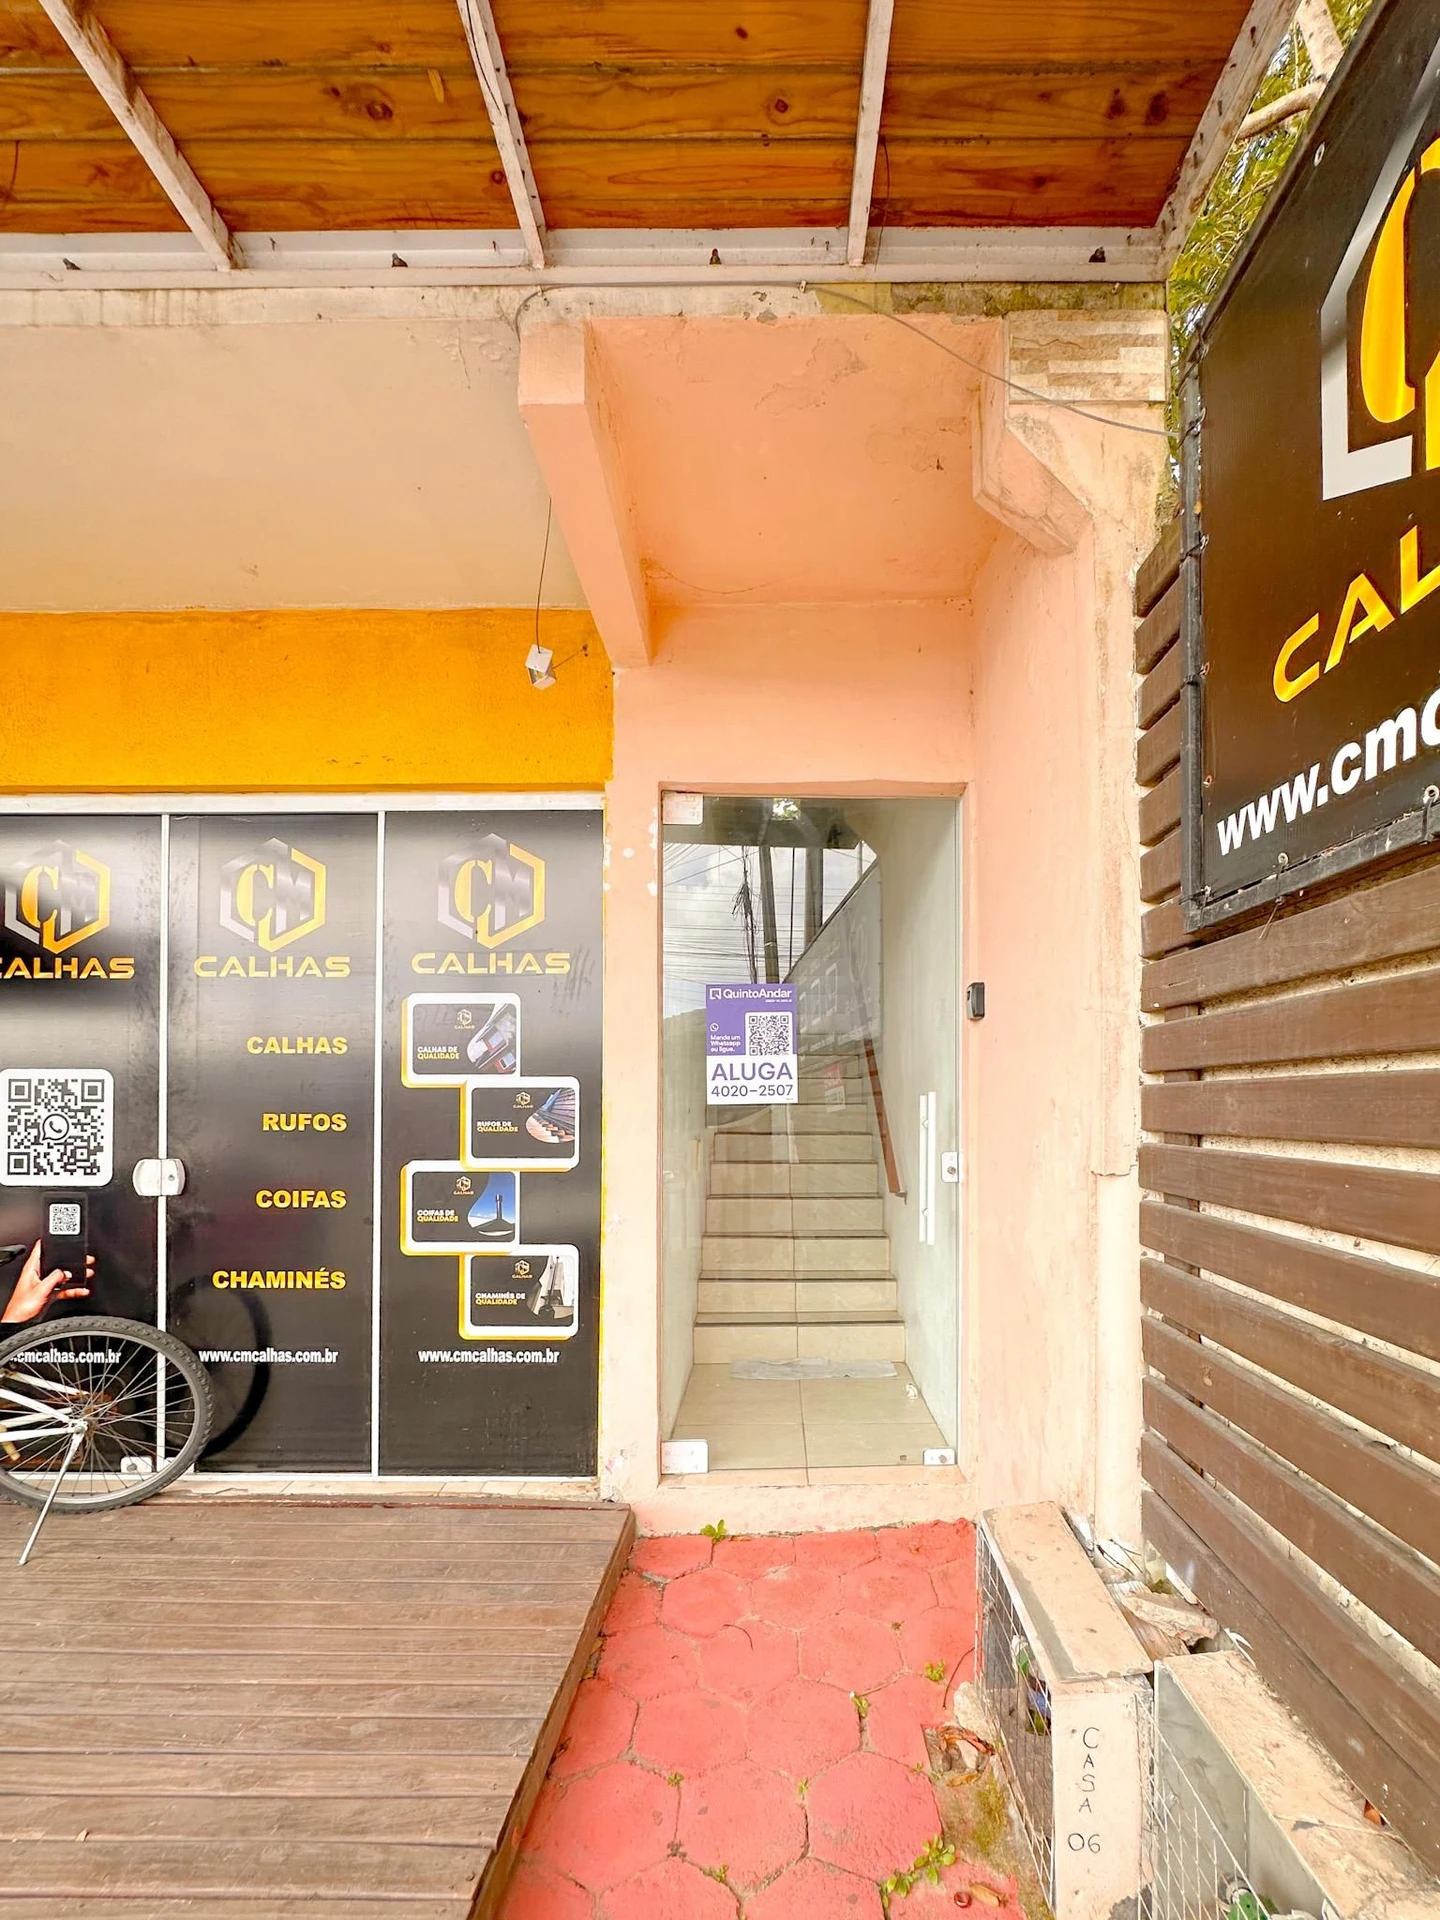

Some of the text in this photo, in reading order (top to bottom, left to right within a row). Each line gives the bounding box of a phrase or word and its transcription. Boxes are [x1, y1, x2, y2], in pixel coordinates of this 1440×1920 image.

[0, 957, 135, 979] ALHAS
[193, 956, 351, 978] CALHAS
[411, 952, 571, 975] CALHAS
[723, 988, 792, 999] QuintoAndar
[247, 1036, 348, 1054] CALHAS
[711, 1062, 793, 1081] ALUGA
[711, 1084, 793, 1097] 4020-2507
[262, 1113, 348, 1132] RUFOS
[255, 1190, 347, 1208] COIFAS
[212, 1267, 346, 1290] CHAMINÉS
[198, 1347, 339, 1363] www.cmcalhas.com.br
[418, 1347, 560, 1363] www.cmcalhas.com.br
[1078, 1726, 1100, 1814] CASA
[1067, 1832, 1100, 1854] 06
